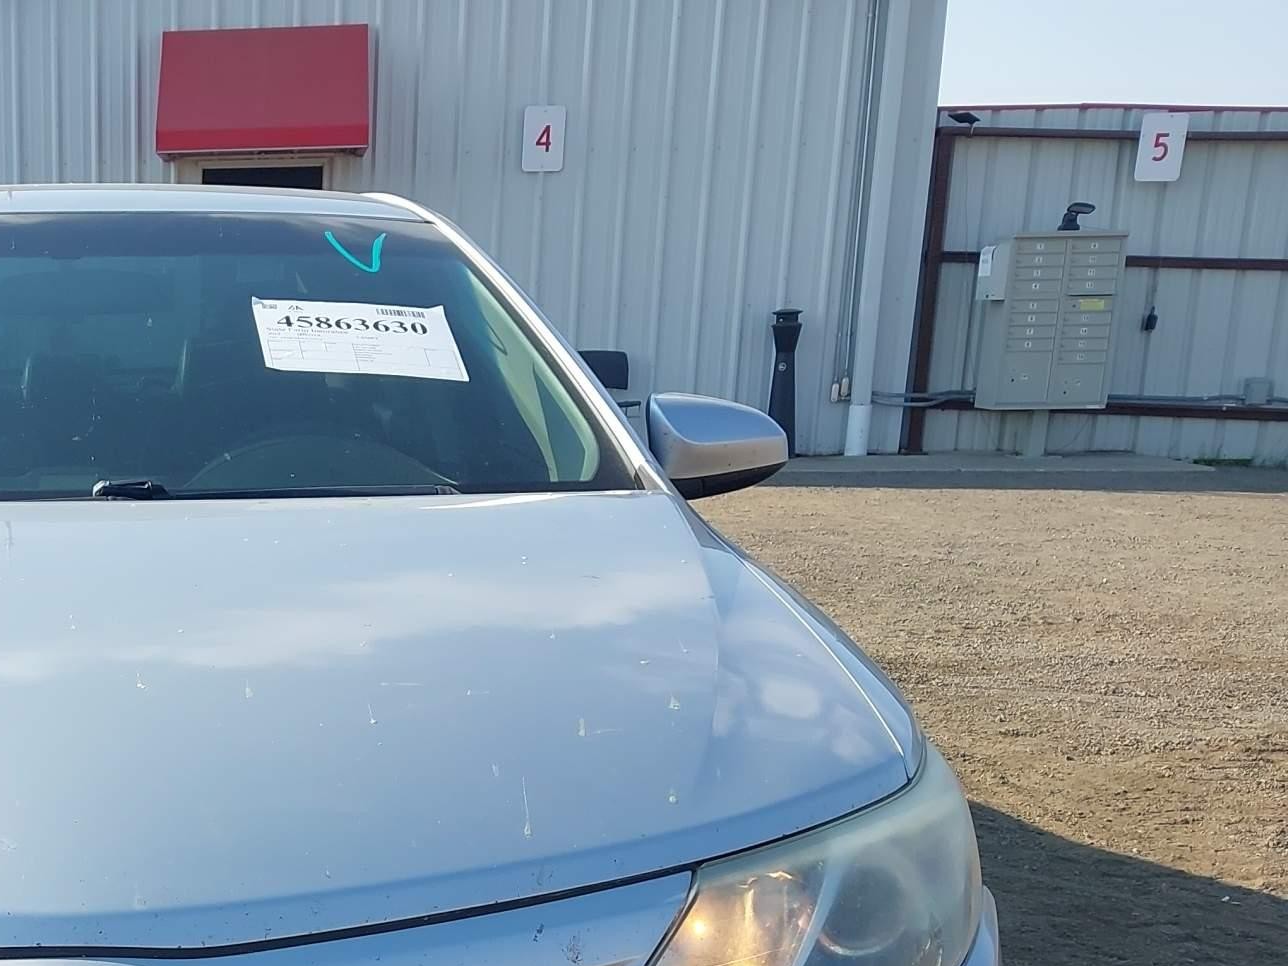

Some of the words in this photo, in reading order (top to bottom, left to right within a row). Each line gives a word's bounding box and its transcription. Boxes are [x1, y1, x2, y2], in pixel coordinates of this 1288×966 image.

[535, 124, 551, 152] 4
[1151, 132, 1170, 162] 5
[277, 314, 428, 336] 45863630
